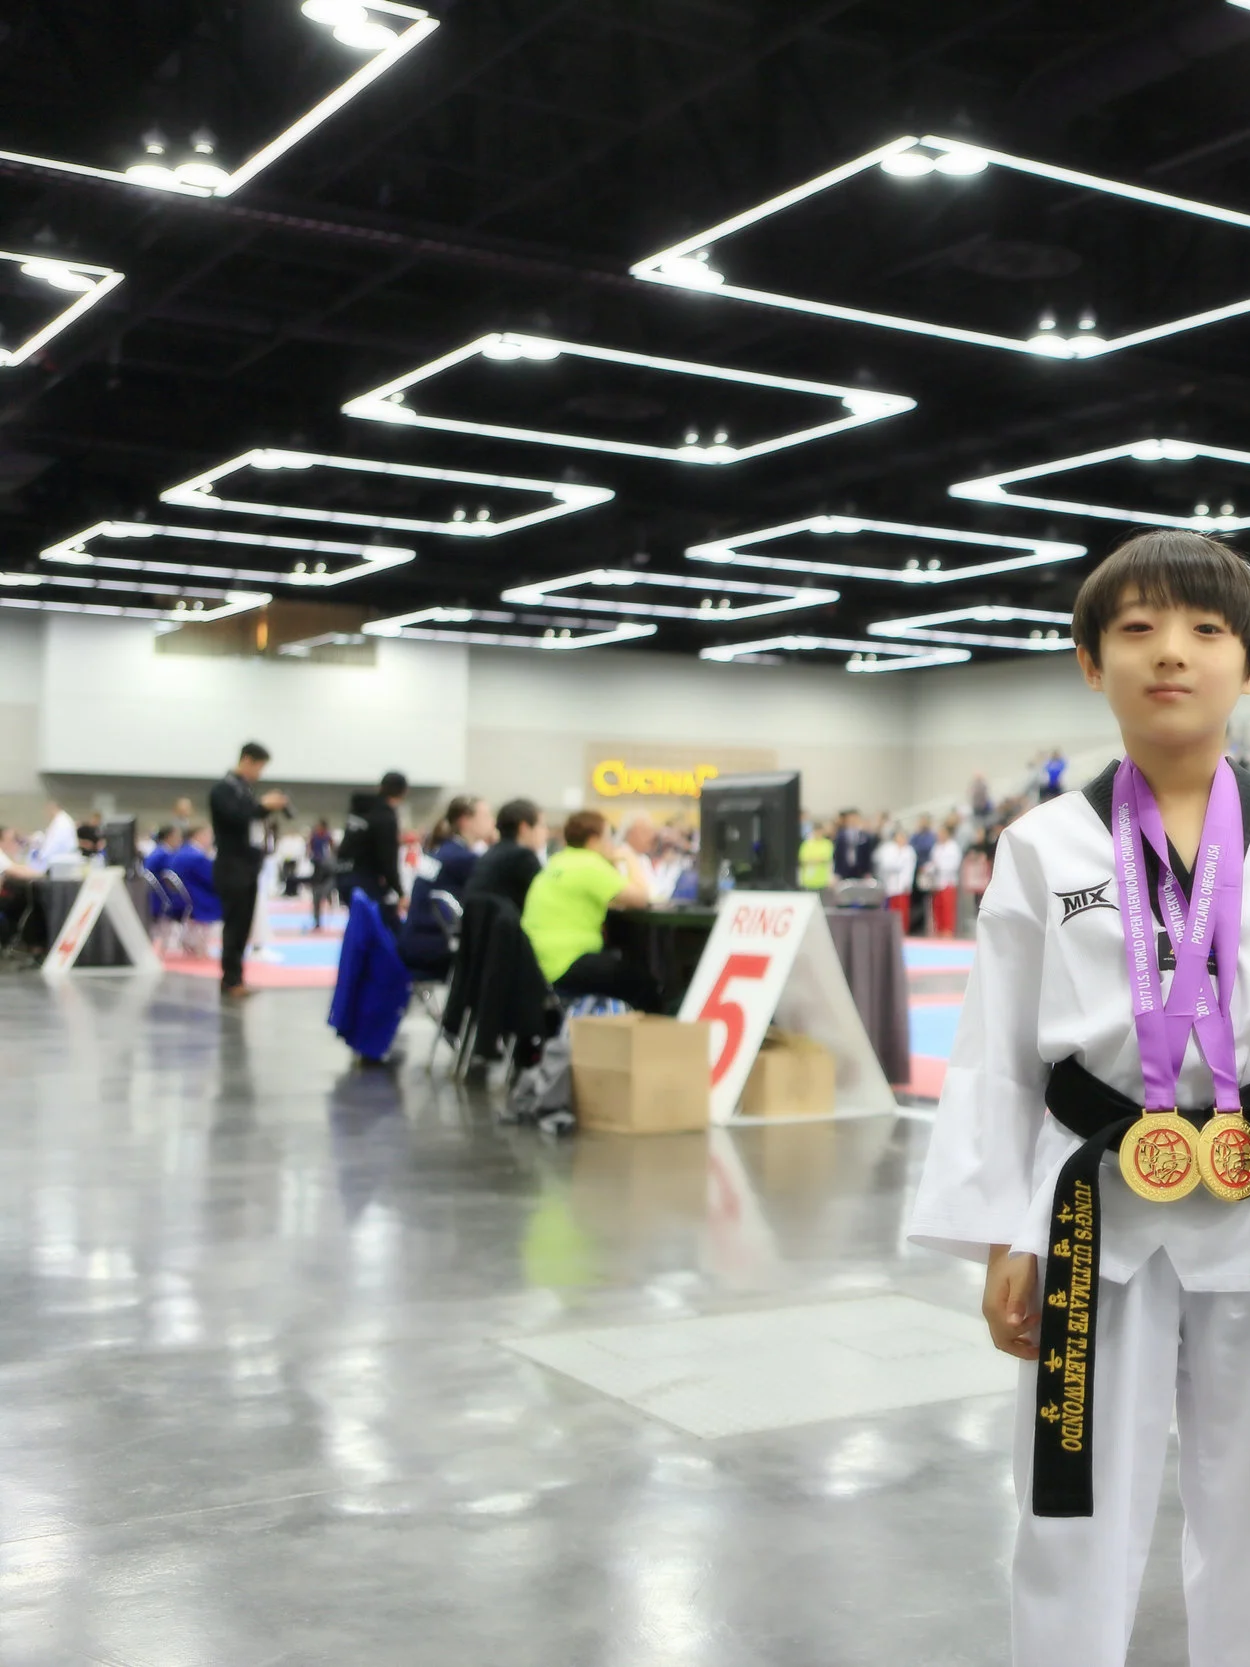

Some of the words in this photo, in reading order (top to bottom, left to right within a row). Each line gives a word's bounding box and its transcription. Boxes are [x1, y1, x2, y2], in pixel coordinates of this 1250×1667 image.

[1118, 802, 1135, 861] CHAMPIONSHIPS
[1207, 844, 1221, 860] USA
[1123, 862, 1142, 916] TAEKWONDO
[1201, 860, 1218, 895] OREGON
[729, 905, 795, 938] RING
[1129, 917, 1145, 939] OPEN
[1191, 897, 1214, 945] PORTLAND,
[1133, 940, 1150, 972] WORLD
[1137, 971, 1151, 990] U.S.
[1140, 991, 1154, 1010] 2017
[698, 954, 772, 1088] 5
[1074, 1179, 1093, 1241] JUNG'S
[1067, 1244, 1092, 1334] ULTIMATE
[1061, 1337, 1088, 1452] TAEKWONDO
